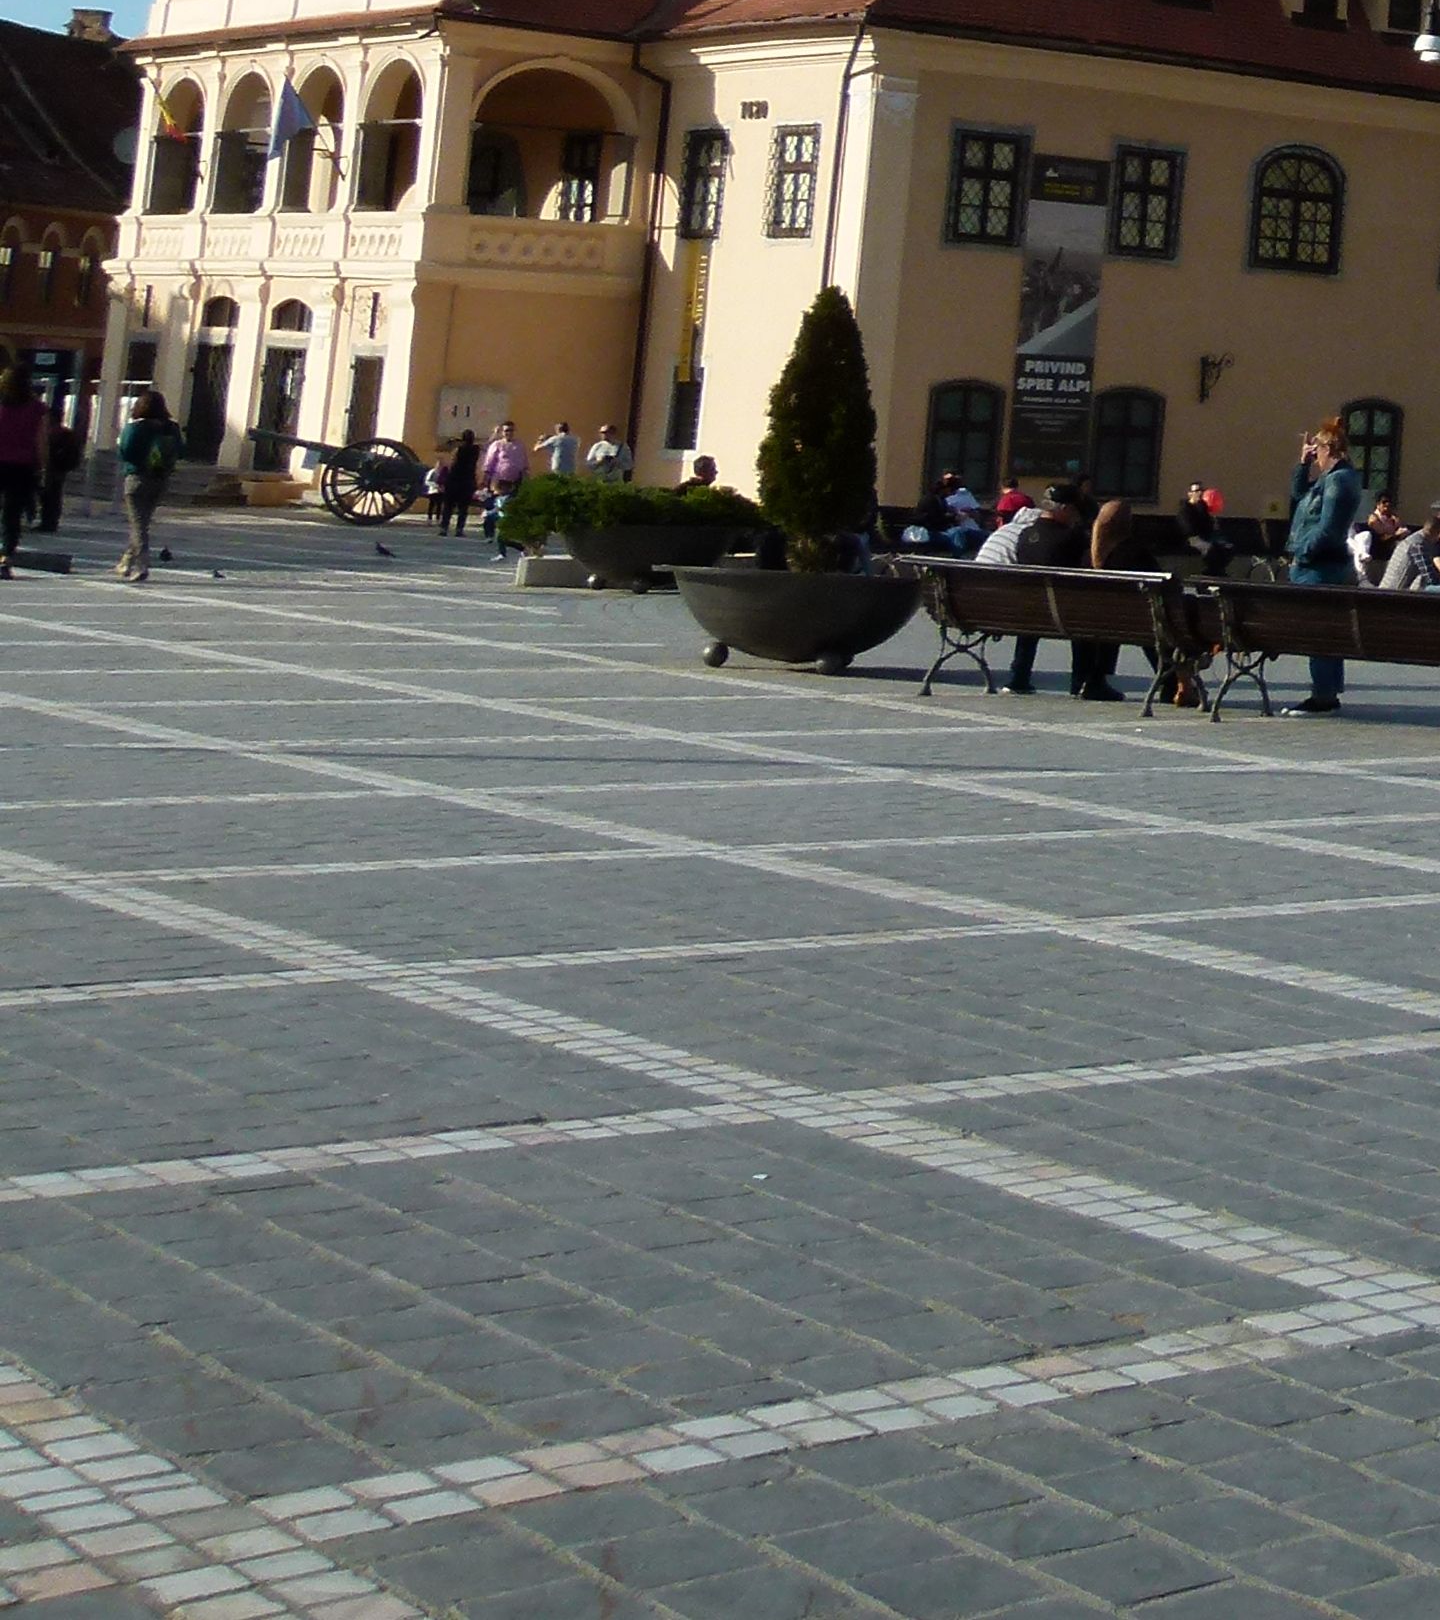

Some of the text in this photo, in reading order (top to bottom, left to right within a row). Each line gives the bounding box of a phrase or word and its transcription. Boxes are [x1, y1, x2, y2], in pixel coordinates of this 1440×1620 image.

[1025, 360, 1086, 375] PRIVIND
[1017, 378, 1091, 392] SPRE ALPI
